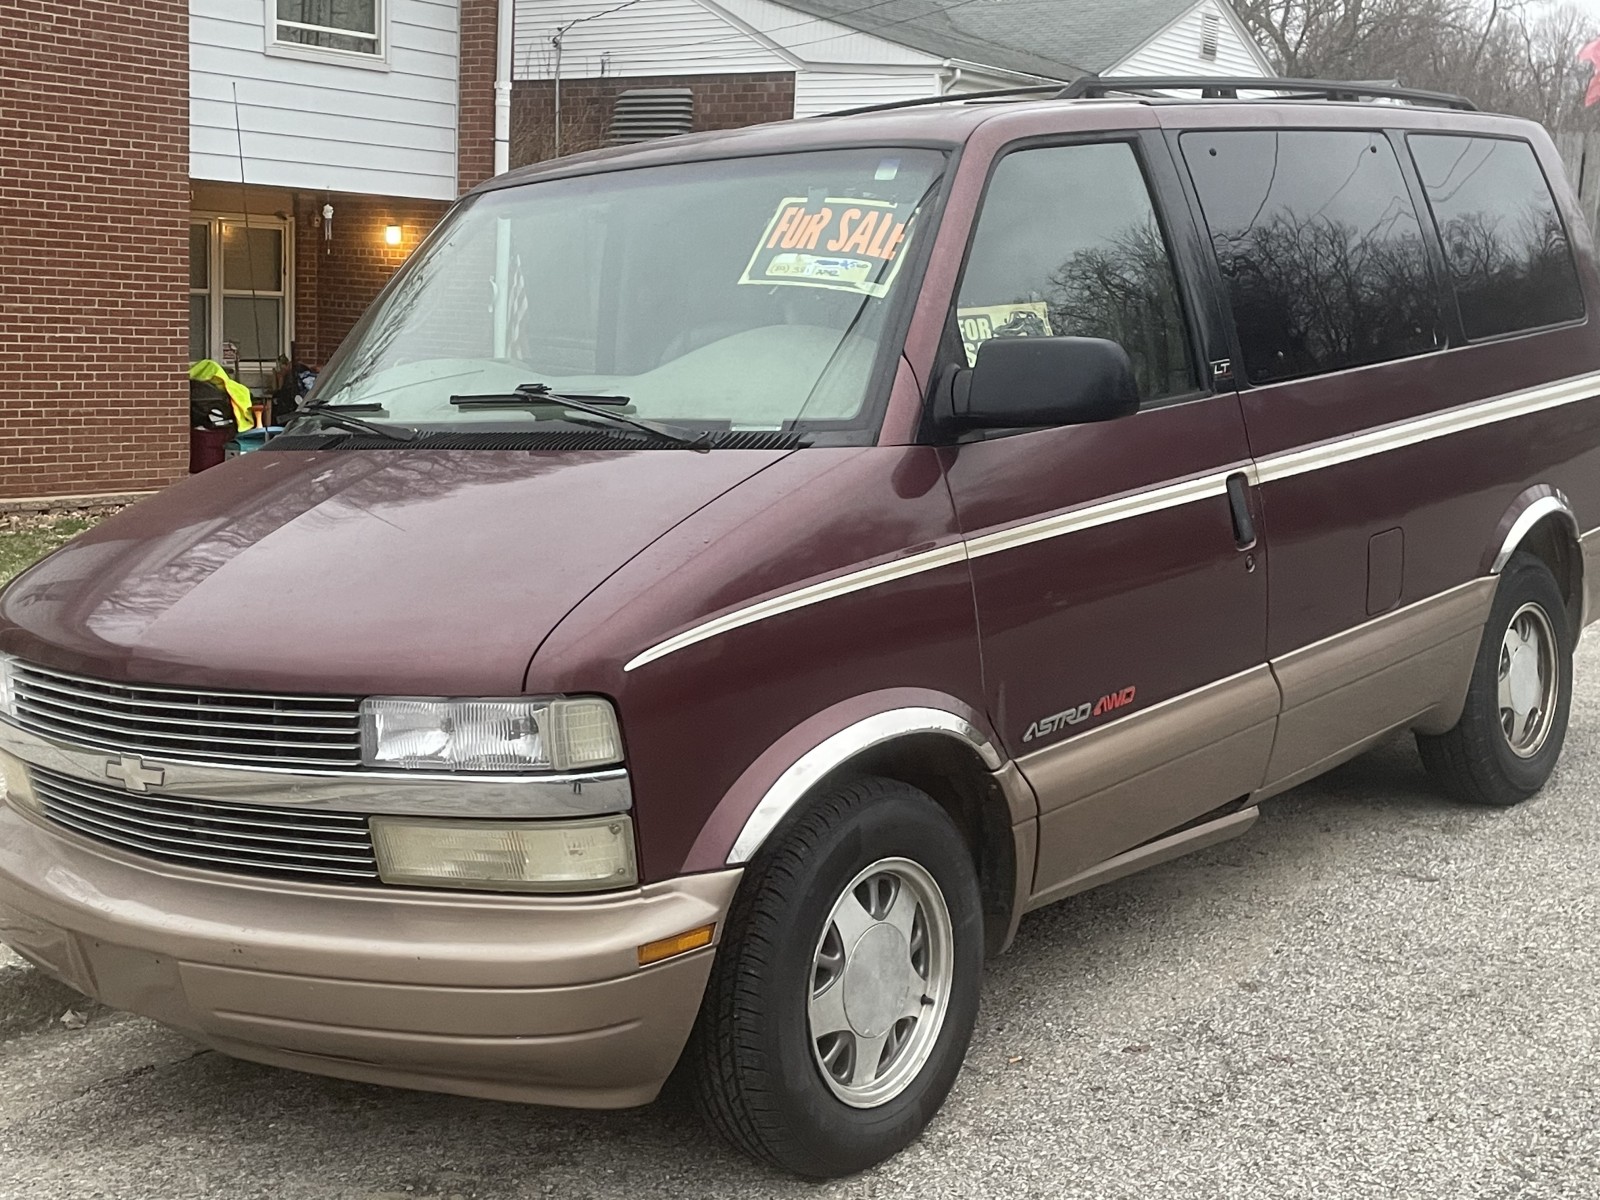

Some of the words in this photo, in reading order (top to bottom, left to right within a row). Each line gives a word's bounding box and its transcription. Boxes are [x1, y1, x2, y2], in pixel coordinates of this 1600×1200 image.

[766, 206, 833, 250] FOR
[827, 208, 907, 260] SALE
[1214, 362, 1230, 375] LT
[1023, 702, 1092, 742] ASTRO
[1093, 685, 1136, 716] AWD
